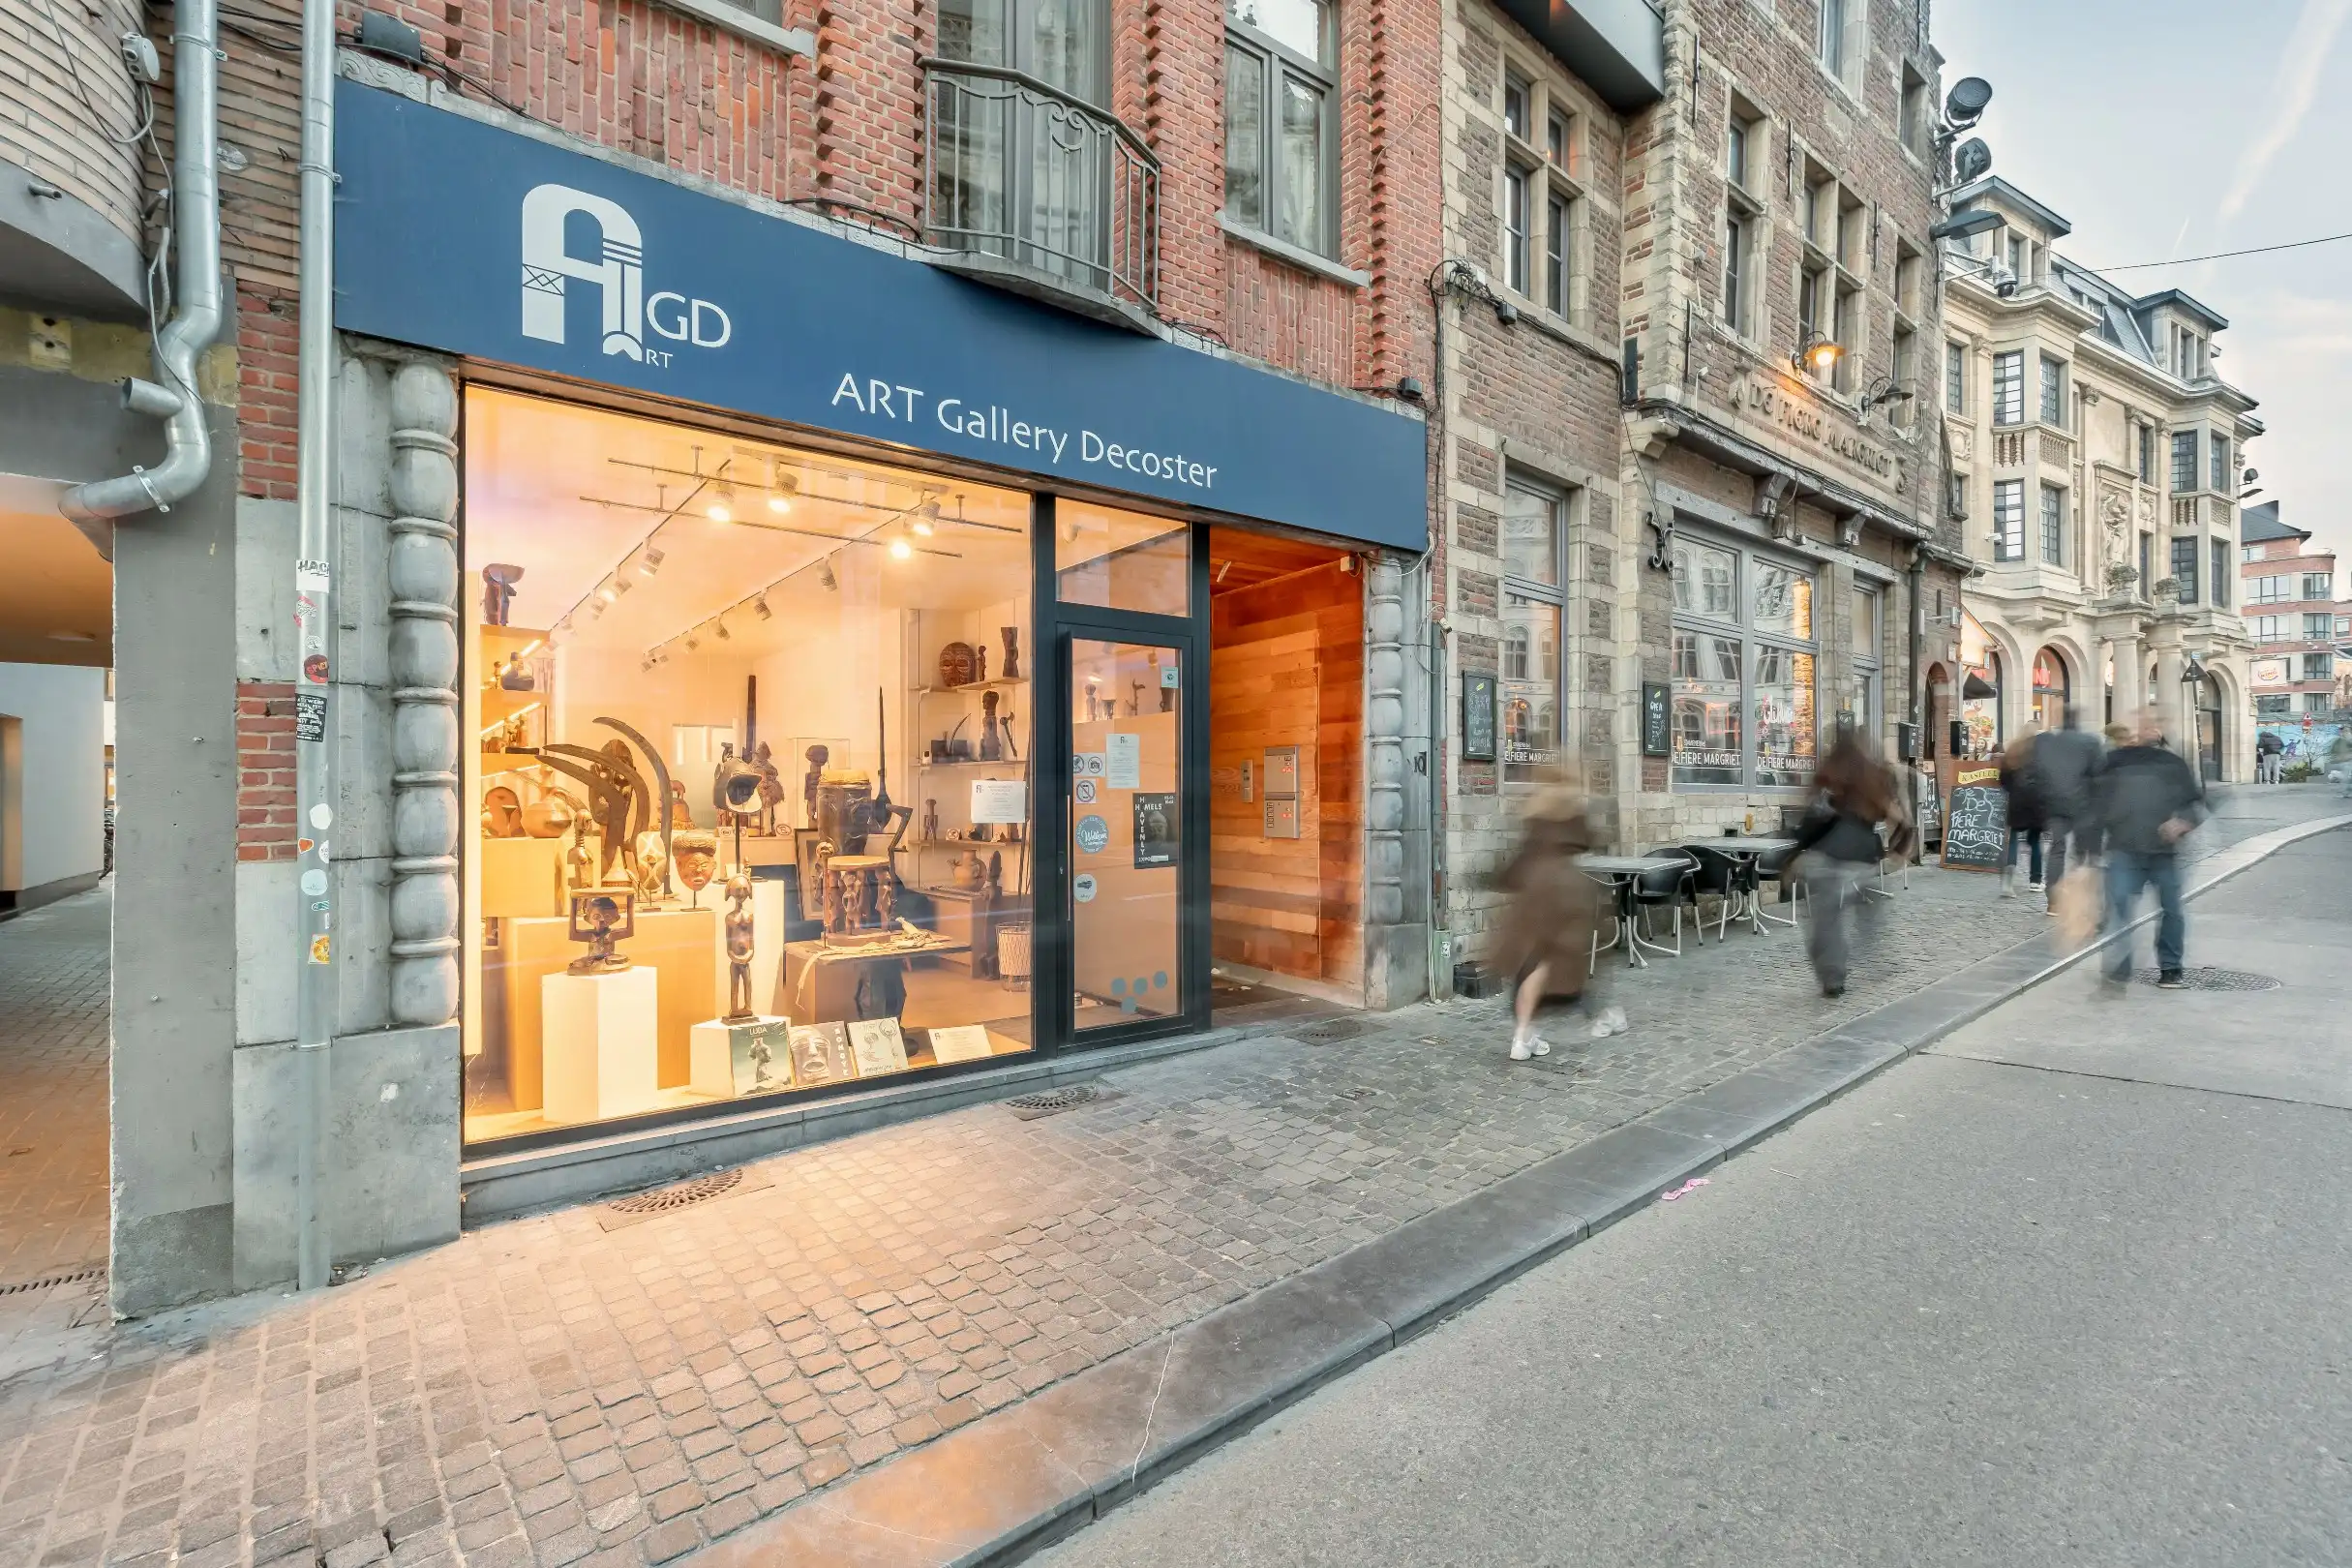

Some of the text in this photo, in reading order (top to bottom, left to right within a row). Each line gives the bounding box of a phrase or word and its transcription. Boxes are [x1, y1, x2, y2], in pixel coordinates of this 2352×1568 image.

[831, 373, 1219, 489] ART Gallery Decoster
[1680, 751, 1703, 765] FIERE
[1704, 753, 1741, 766] MARGRIET
[1965, 797, 1988, 812] De
